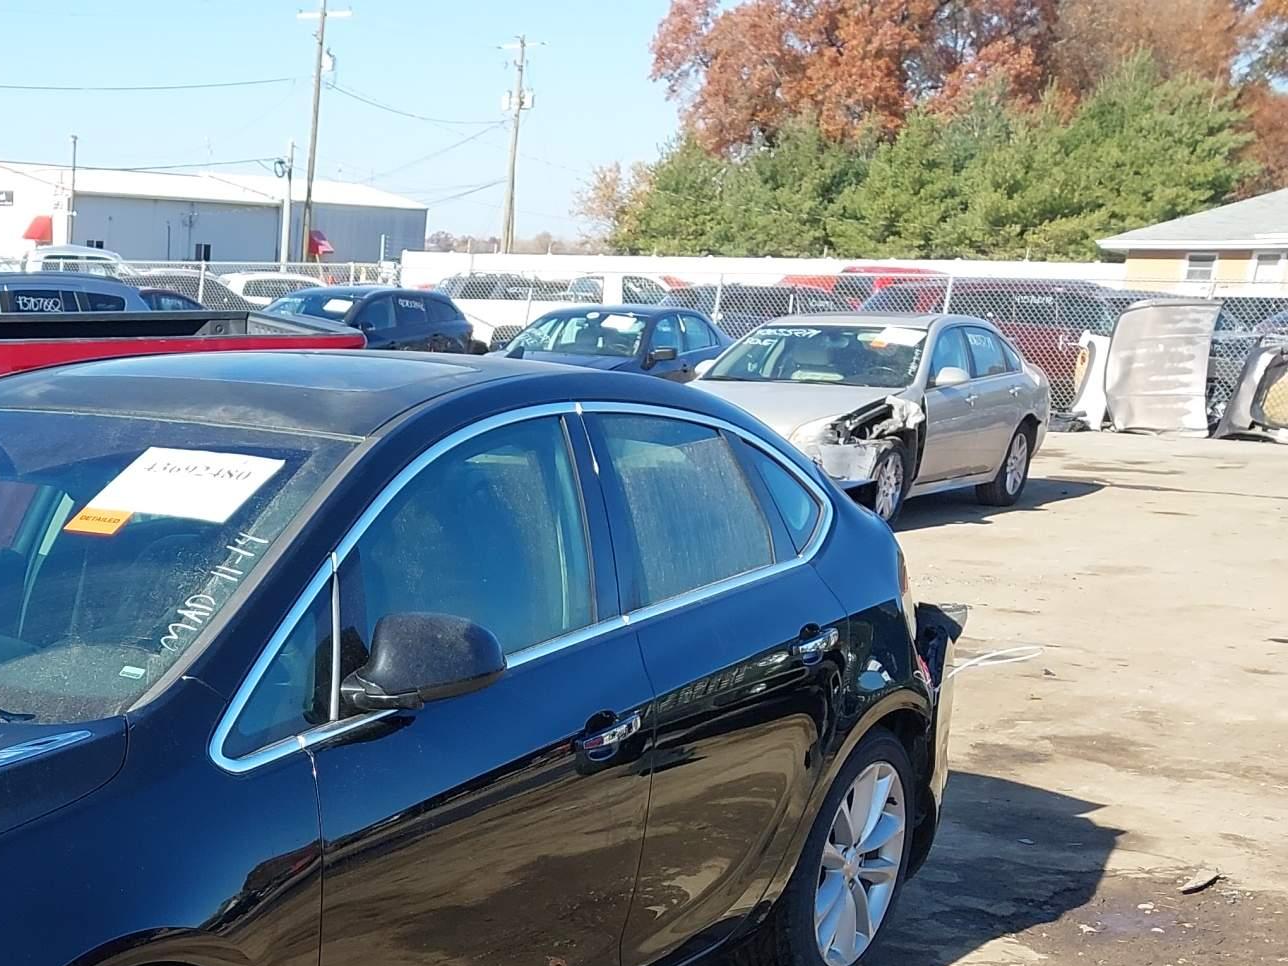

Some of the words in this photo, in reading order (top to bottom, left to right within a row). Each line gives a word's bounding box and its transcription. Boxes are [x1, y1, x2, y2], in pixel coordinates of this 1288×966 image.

[78, 513, 121, 524] DETAILED
[160, 593, 217, 652] MAD
[210, 531, 270, 583] 11-14
